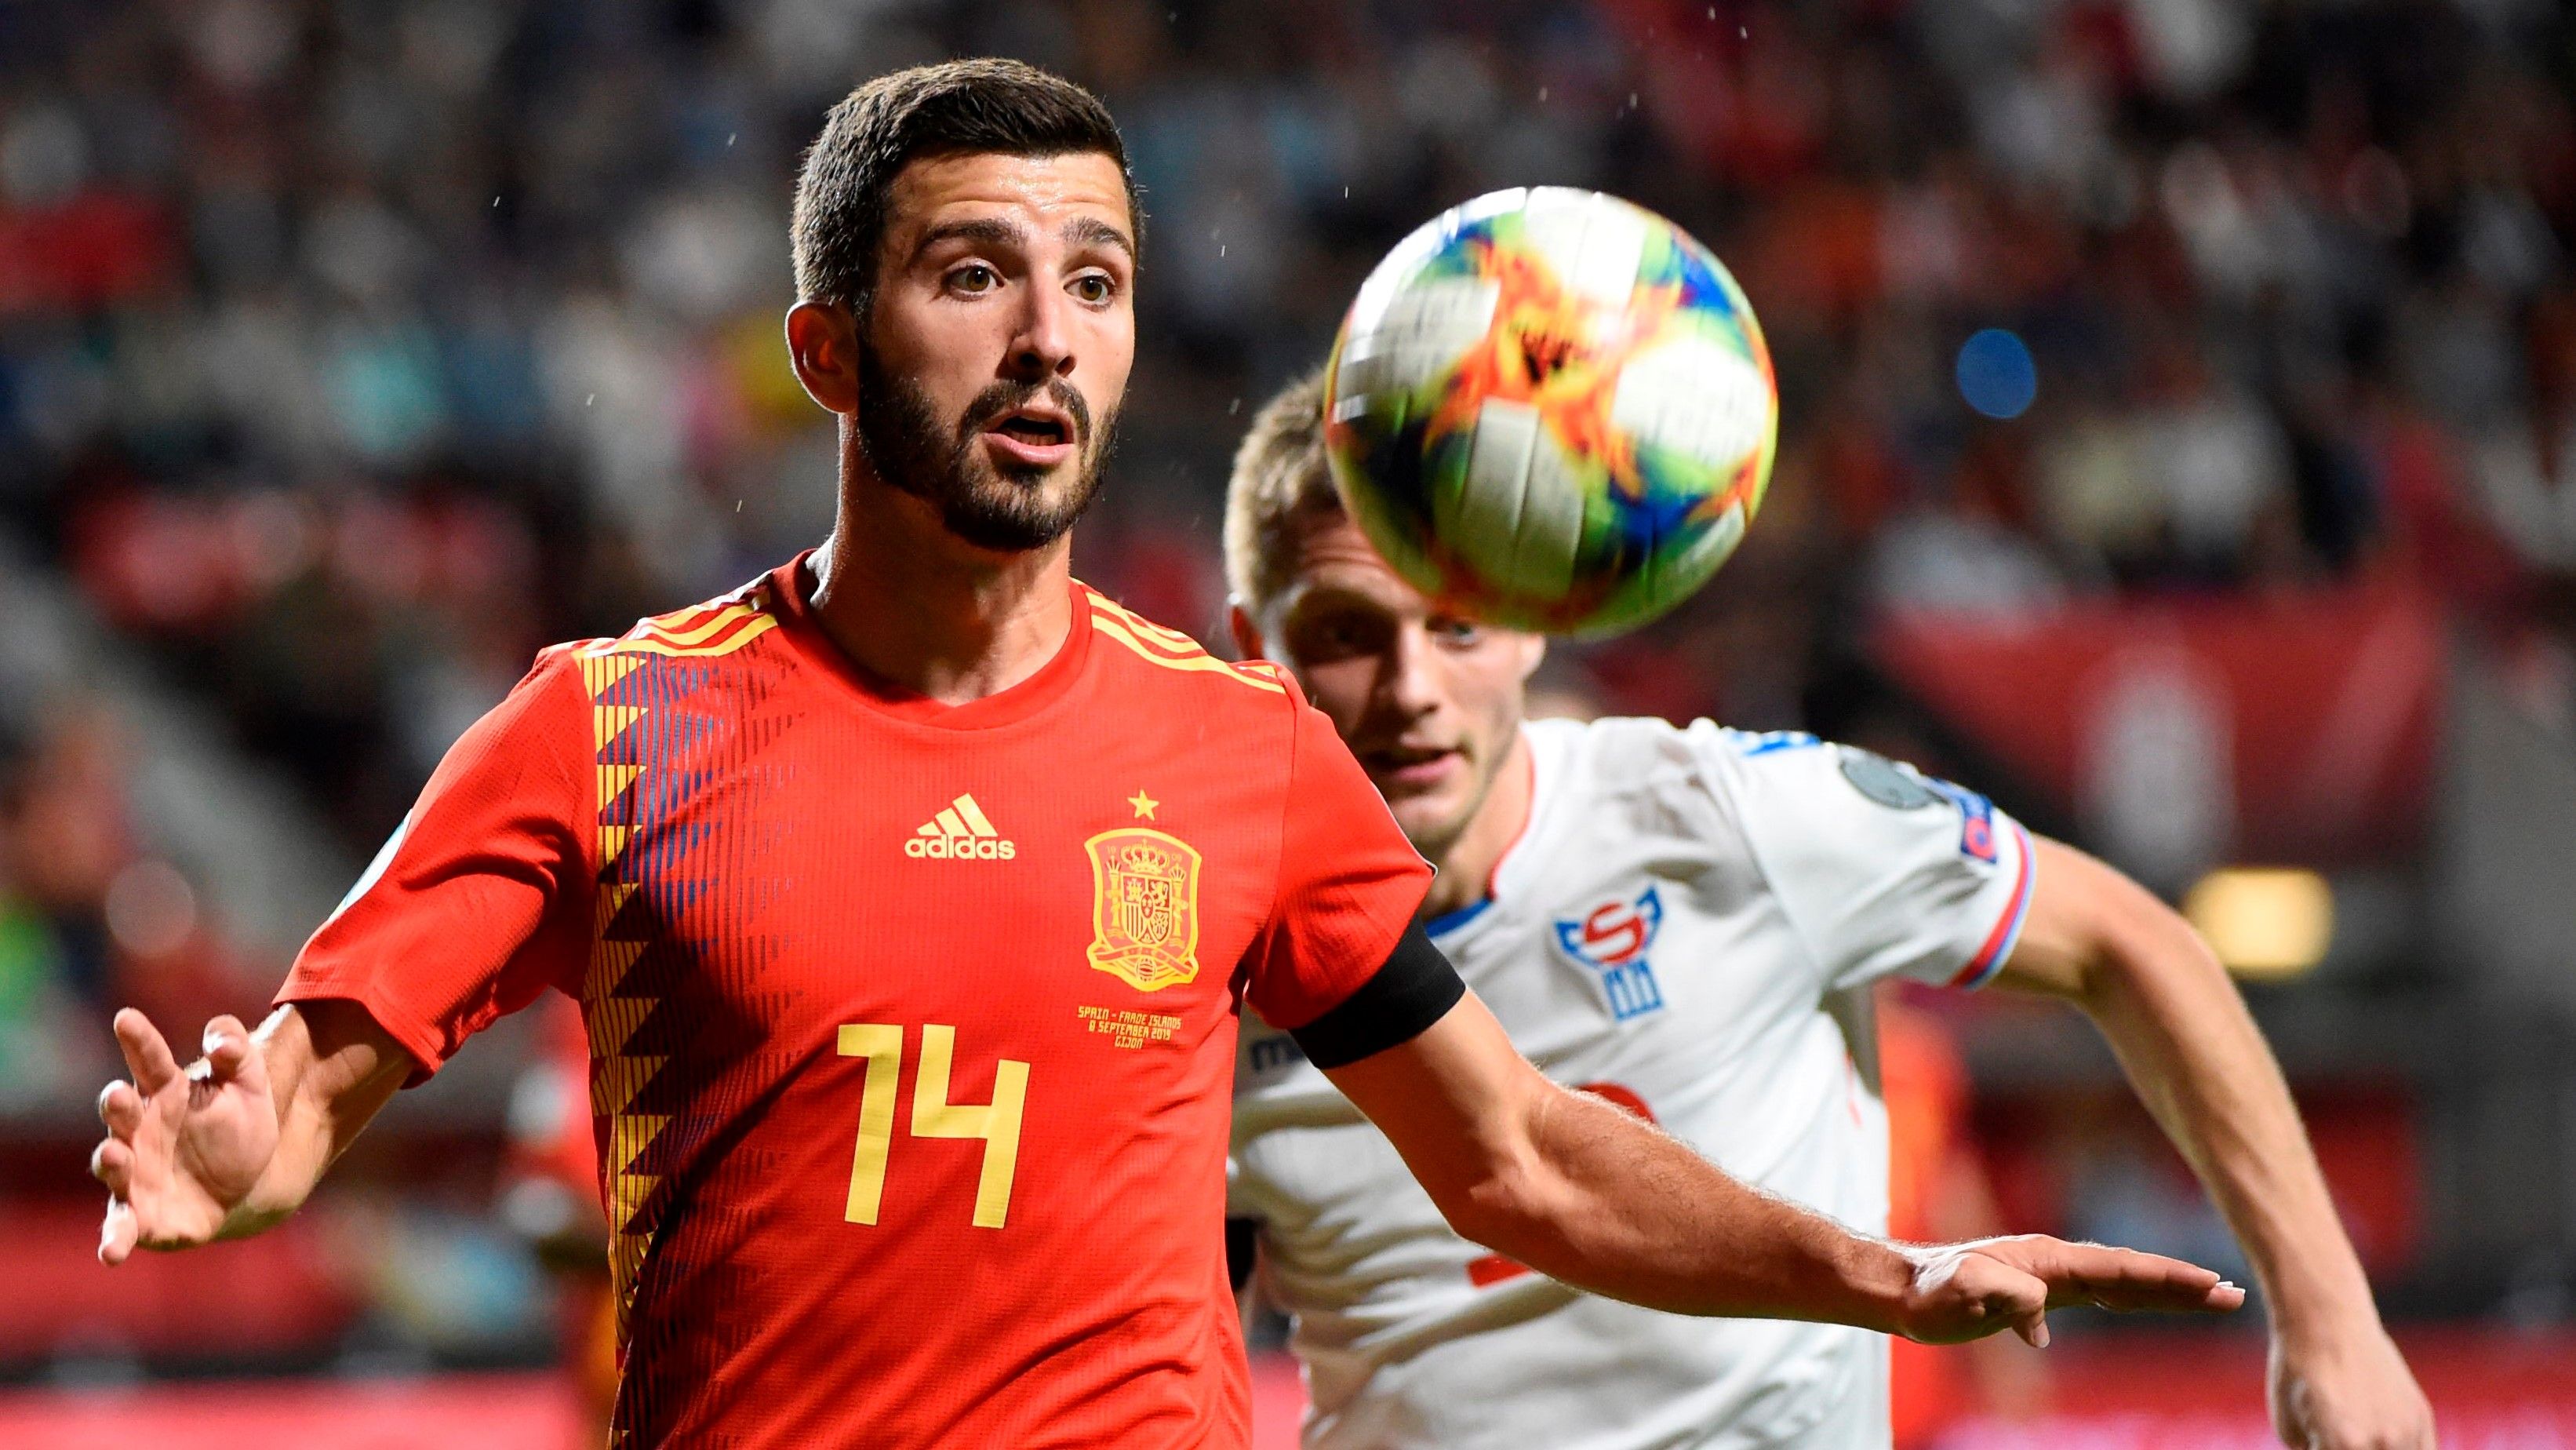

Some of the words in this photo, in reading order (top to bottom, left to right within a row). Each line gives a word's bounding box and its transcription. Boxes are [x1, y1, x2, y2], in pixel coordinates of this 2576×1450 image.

[904, 833, 1016, 860] adidas
[1078, 1006, 1109, 1020] SPAIN
[1148, 1015, 1182, 1029] ISLANDS
[1098, 1021, 1149, 1038] SEPTEMBER
[1151, 1028, 1171, 1040] 2019
[1115, 1036, 1144, 1050] GIJON
[837, 1023, 1031, 1230] 14
